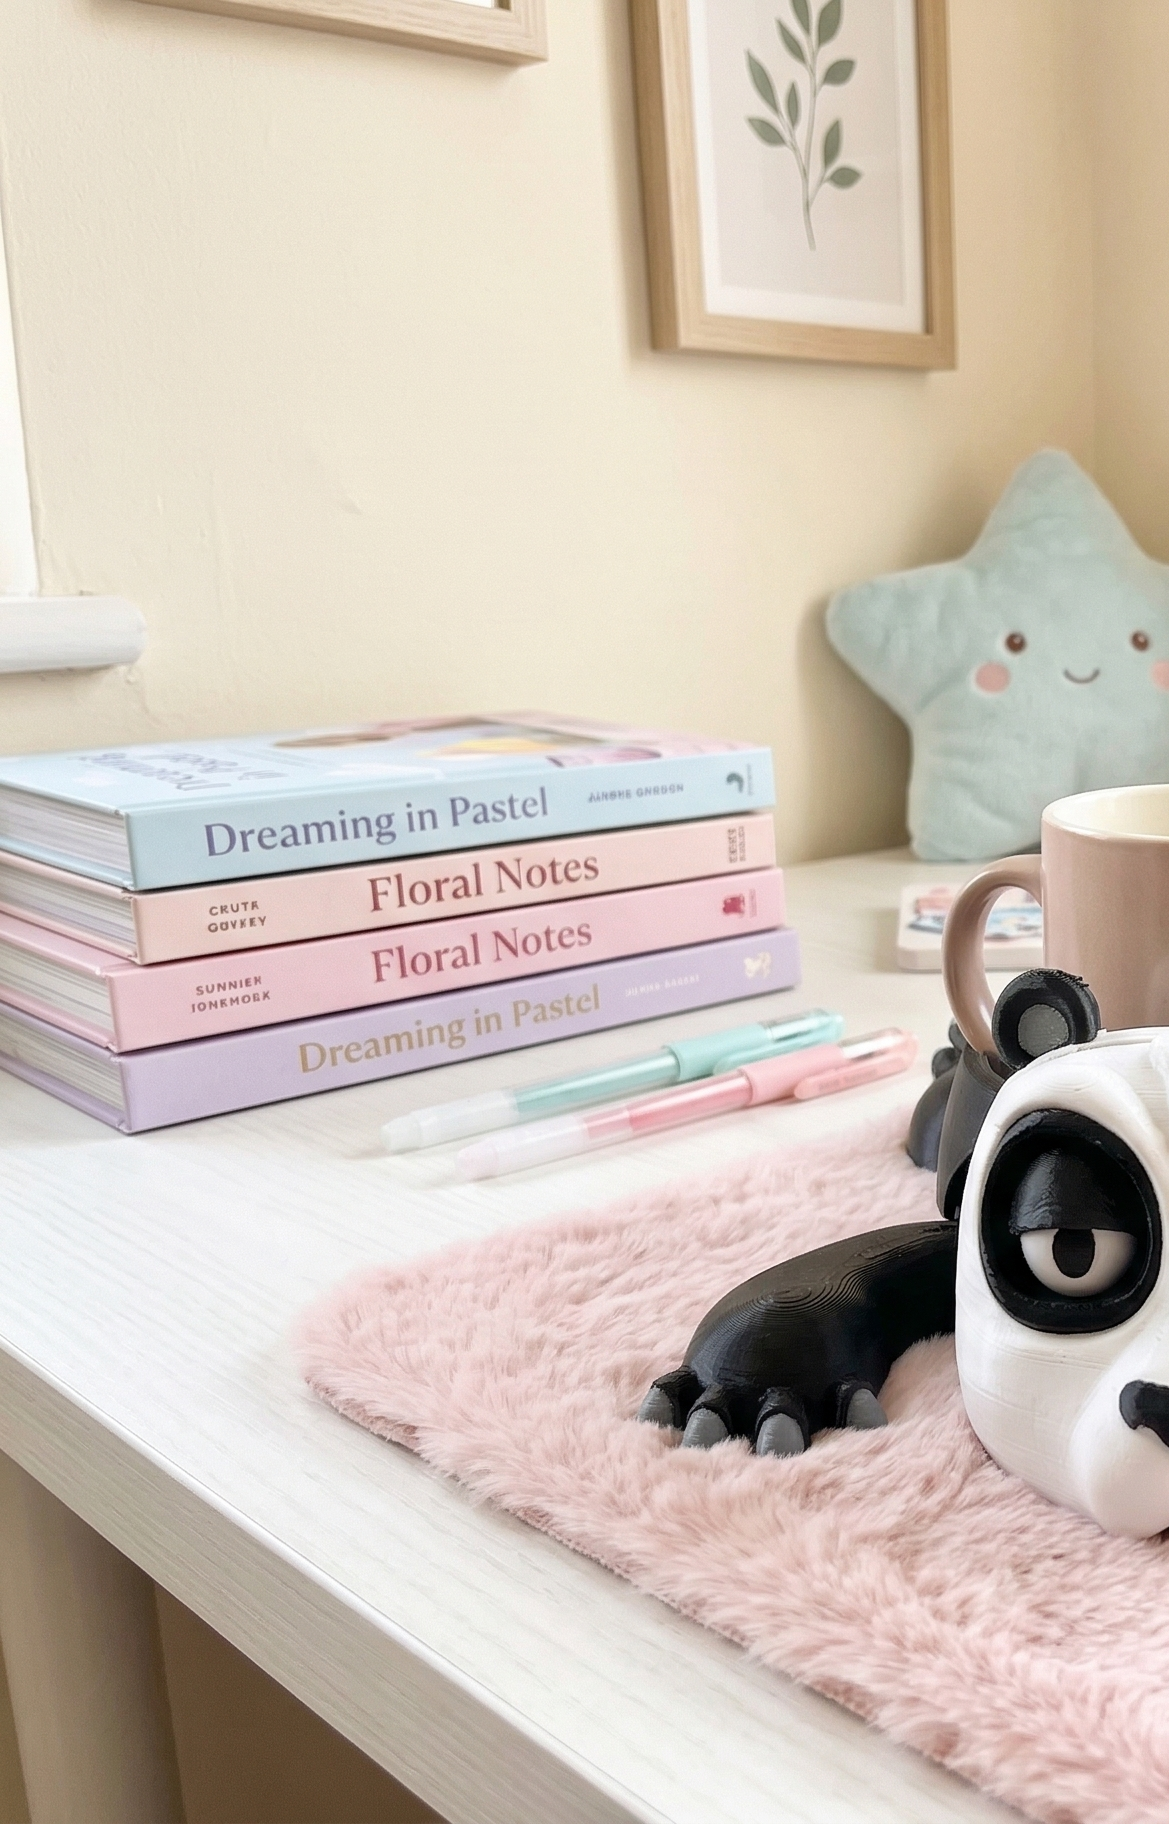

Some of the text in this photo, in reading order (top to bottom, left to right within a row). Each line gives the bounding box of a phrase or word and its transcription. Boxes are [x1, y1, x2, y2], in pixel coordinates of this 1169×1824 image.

[204, 786, 549, 857] Dreaming in Pastel
[367, 855, 600, 913] Floral Notes
[371, 922, 593, 983] Floral Notes
[298, 1018, 467, 1074] Dreaming
[474, 1008, 502, 1036] in
[512, 983, 600, 1028] Pastel
